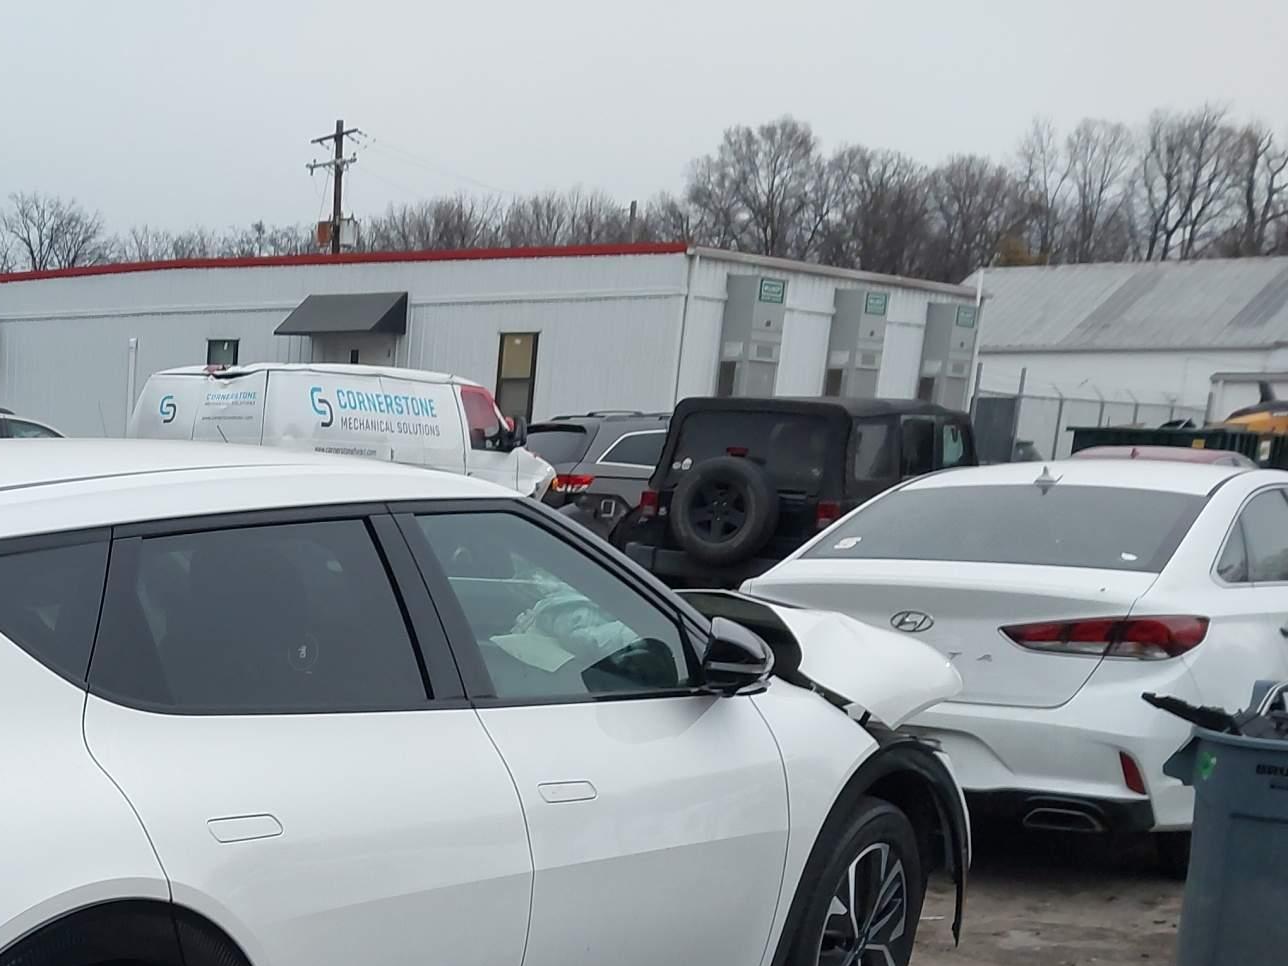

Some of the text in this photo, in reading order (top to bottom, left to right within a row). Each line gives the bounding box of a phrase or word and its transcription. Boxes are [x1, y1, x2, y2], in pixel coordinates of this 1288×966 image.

[336, 389, 438, 418] CORNERSTONE
[340, 416, 441, 437] MECHANICAL SOLUTIONS
